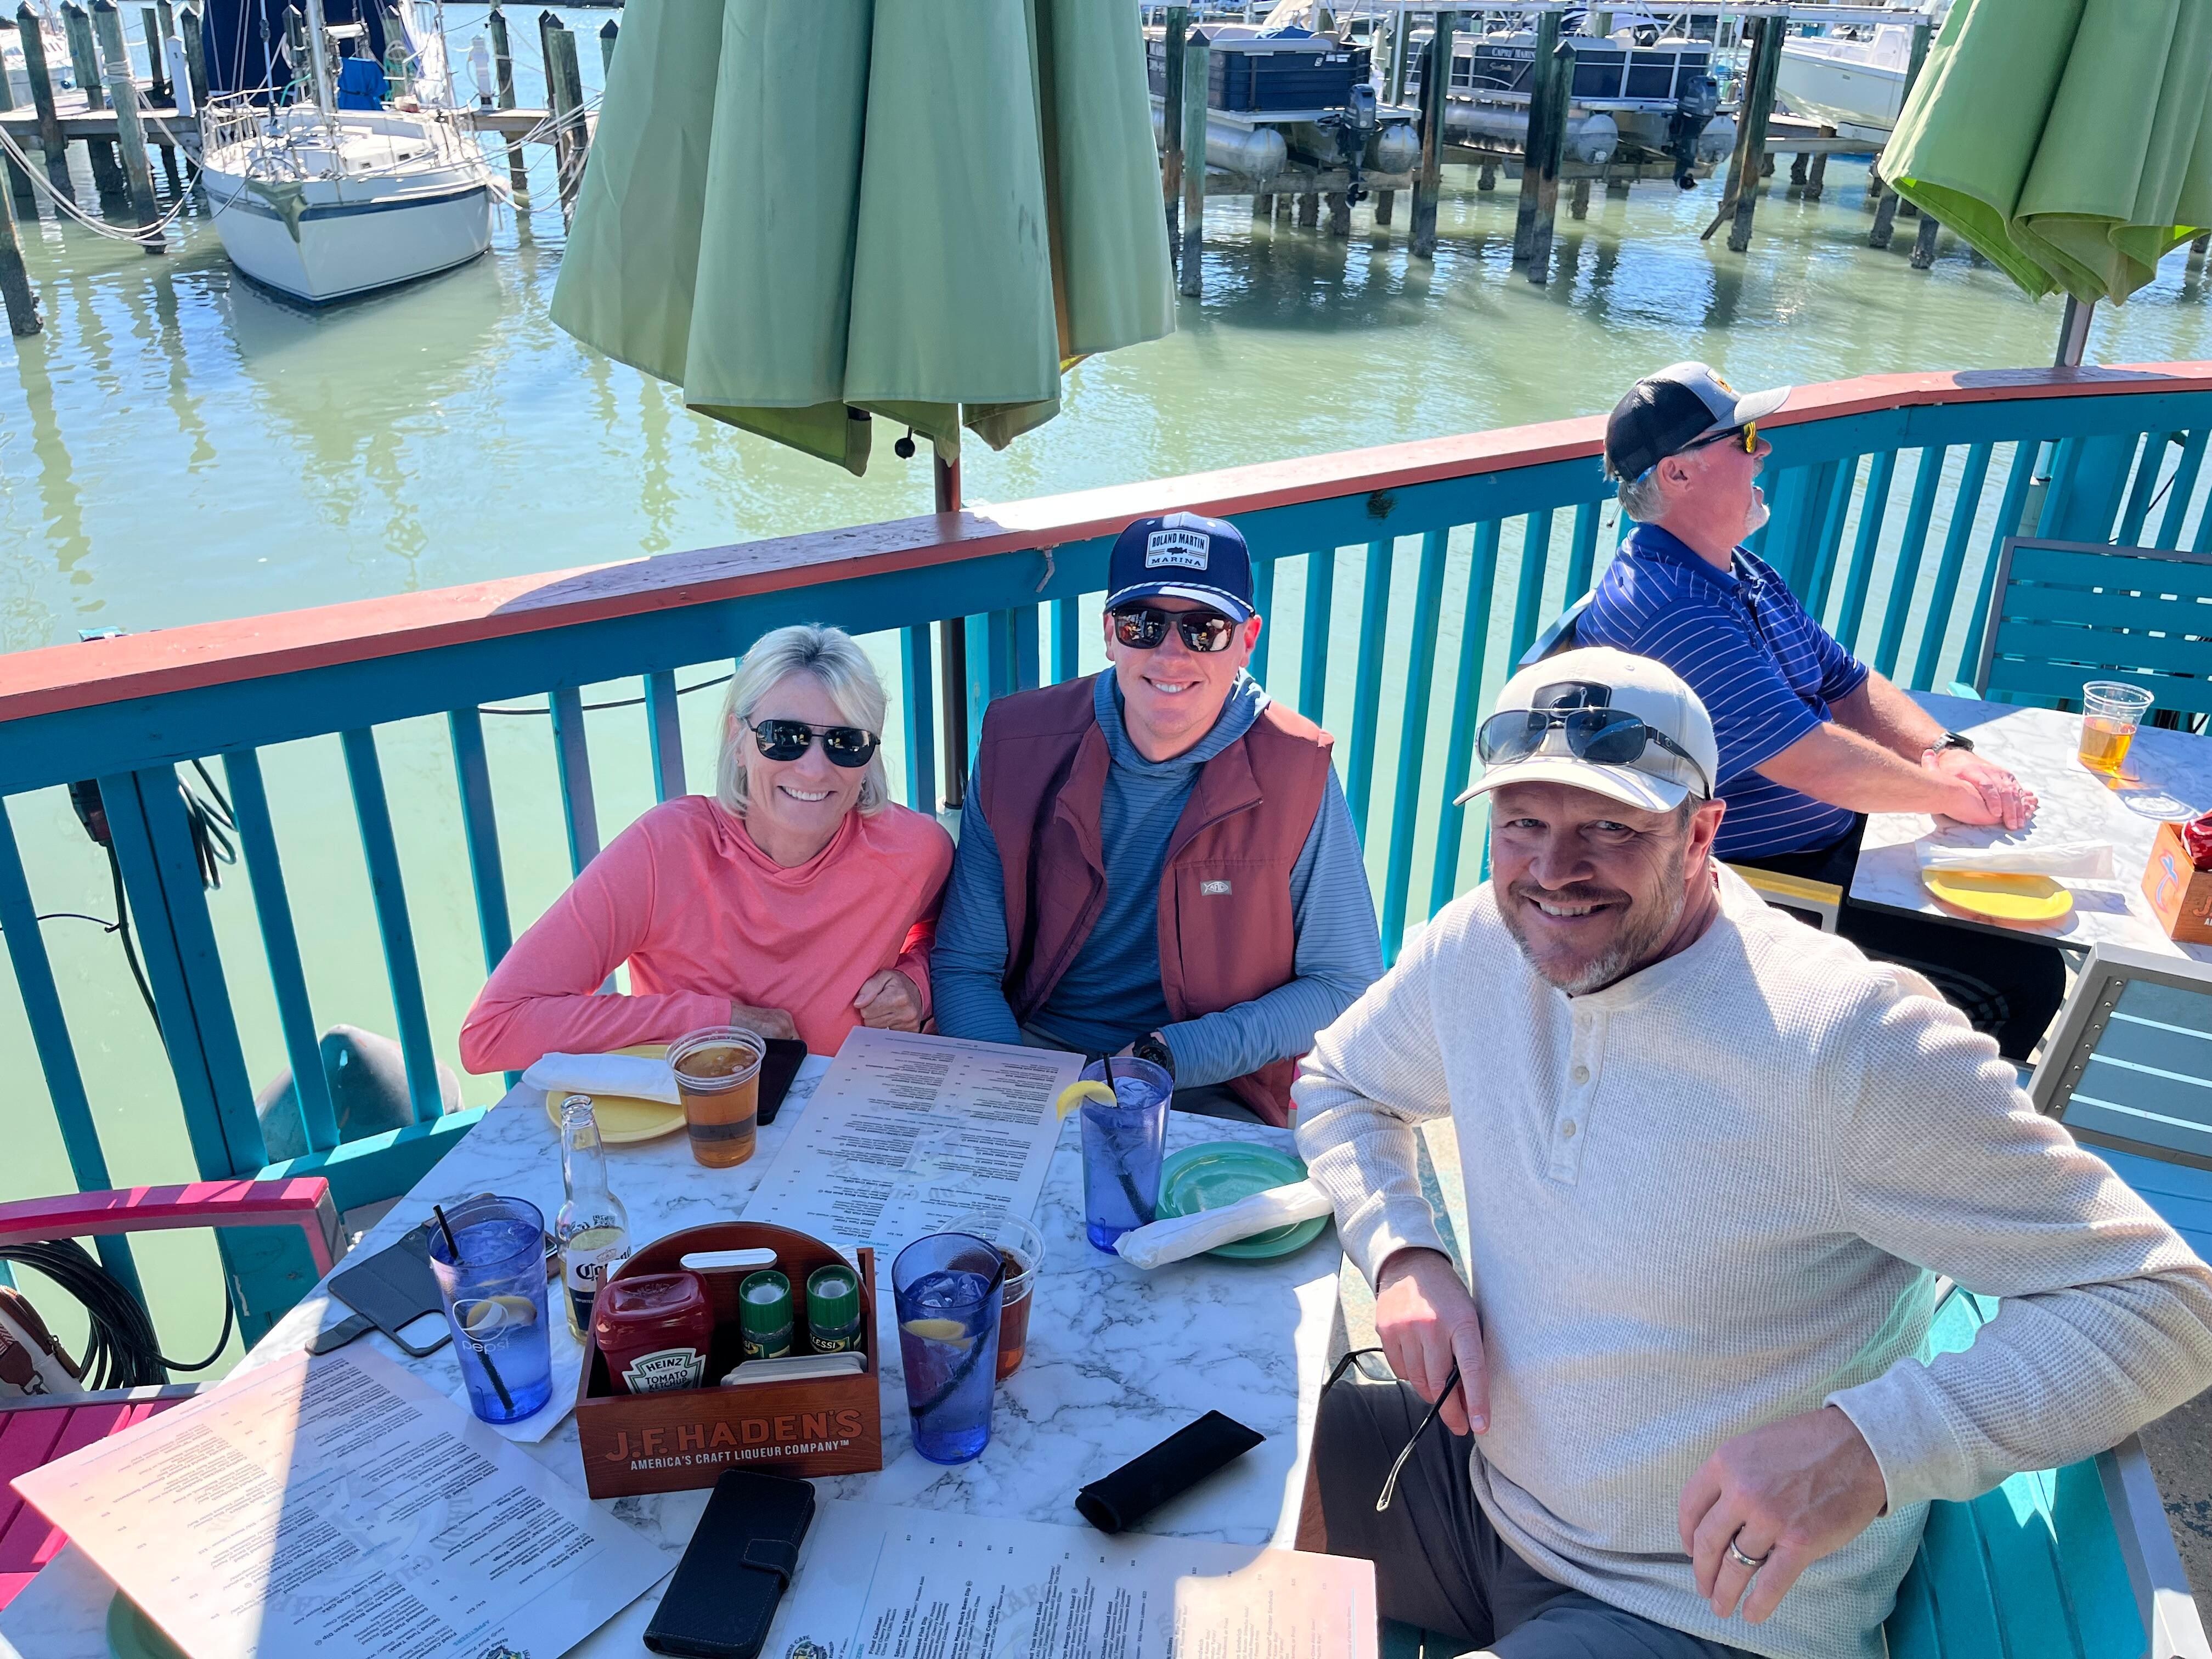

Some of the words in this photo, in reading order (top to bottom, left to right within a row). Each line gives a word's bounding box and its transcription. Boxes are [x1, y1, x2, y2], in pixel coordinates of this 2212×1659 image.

[1152, 533, 1177, 548] ROLAND
[1179, 534, 1205, 549] MARTIN
[1152, 557, 1201, 566] MARINA
[462, 1338, 509, 1355] pepsi
[810, 1334, 836, 1349] LESSI
[646, 1358, 683, 1372] HEINZ
[645, 1370, 688, 1385] TOMATO
[648, 1378, 687, 1390] KETCHUP
[605, 1428, 668, 1462] J.F.
[678, 1409, 863, 1452] HADEN'S
[631, 1455, 692, 1471] AMERICA'S
[696, 1451, 731, 1464] CRAFT
[735, 1447, 782, 1460] LIQUEUR
[381, 1628, 393, 1639] Dip
[405, 1629, 421, 1641] Tuna
[441, 1631, 457, 1644] Fried
[452, 1619, 490, 1647] APPETIZERS
[868, 1640, 876, 1655] Fried
